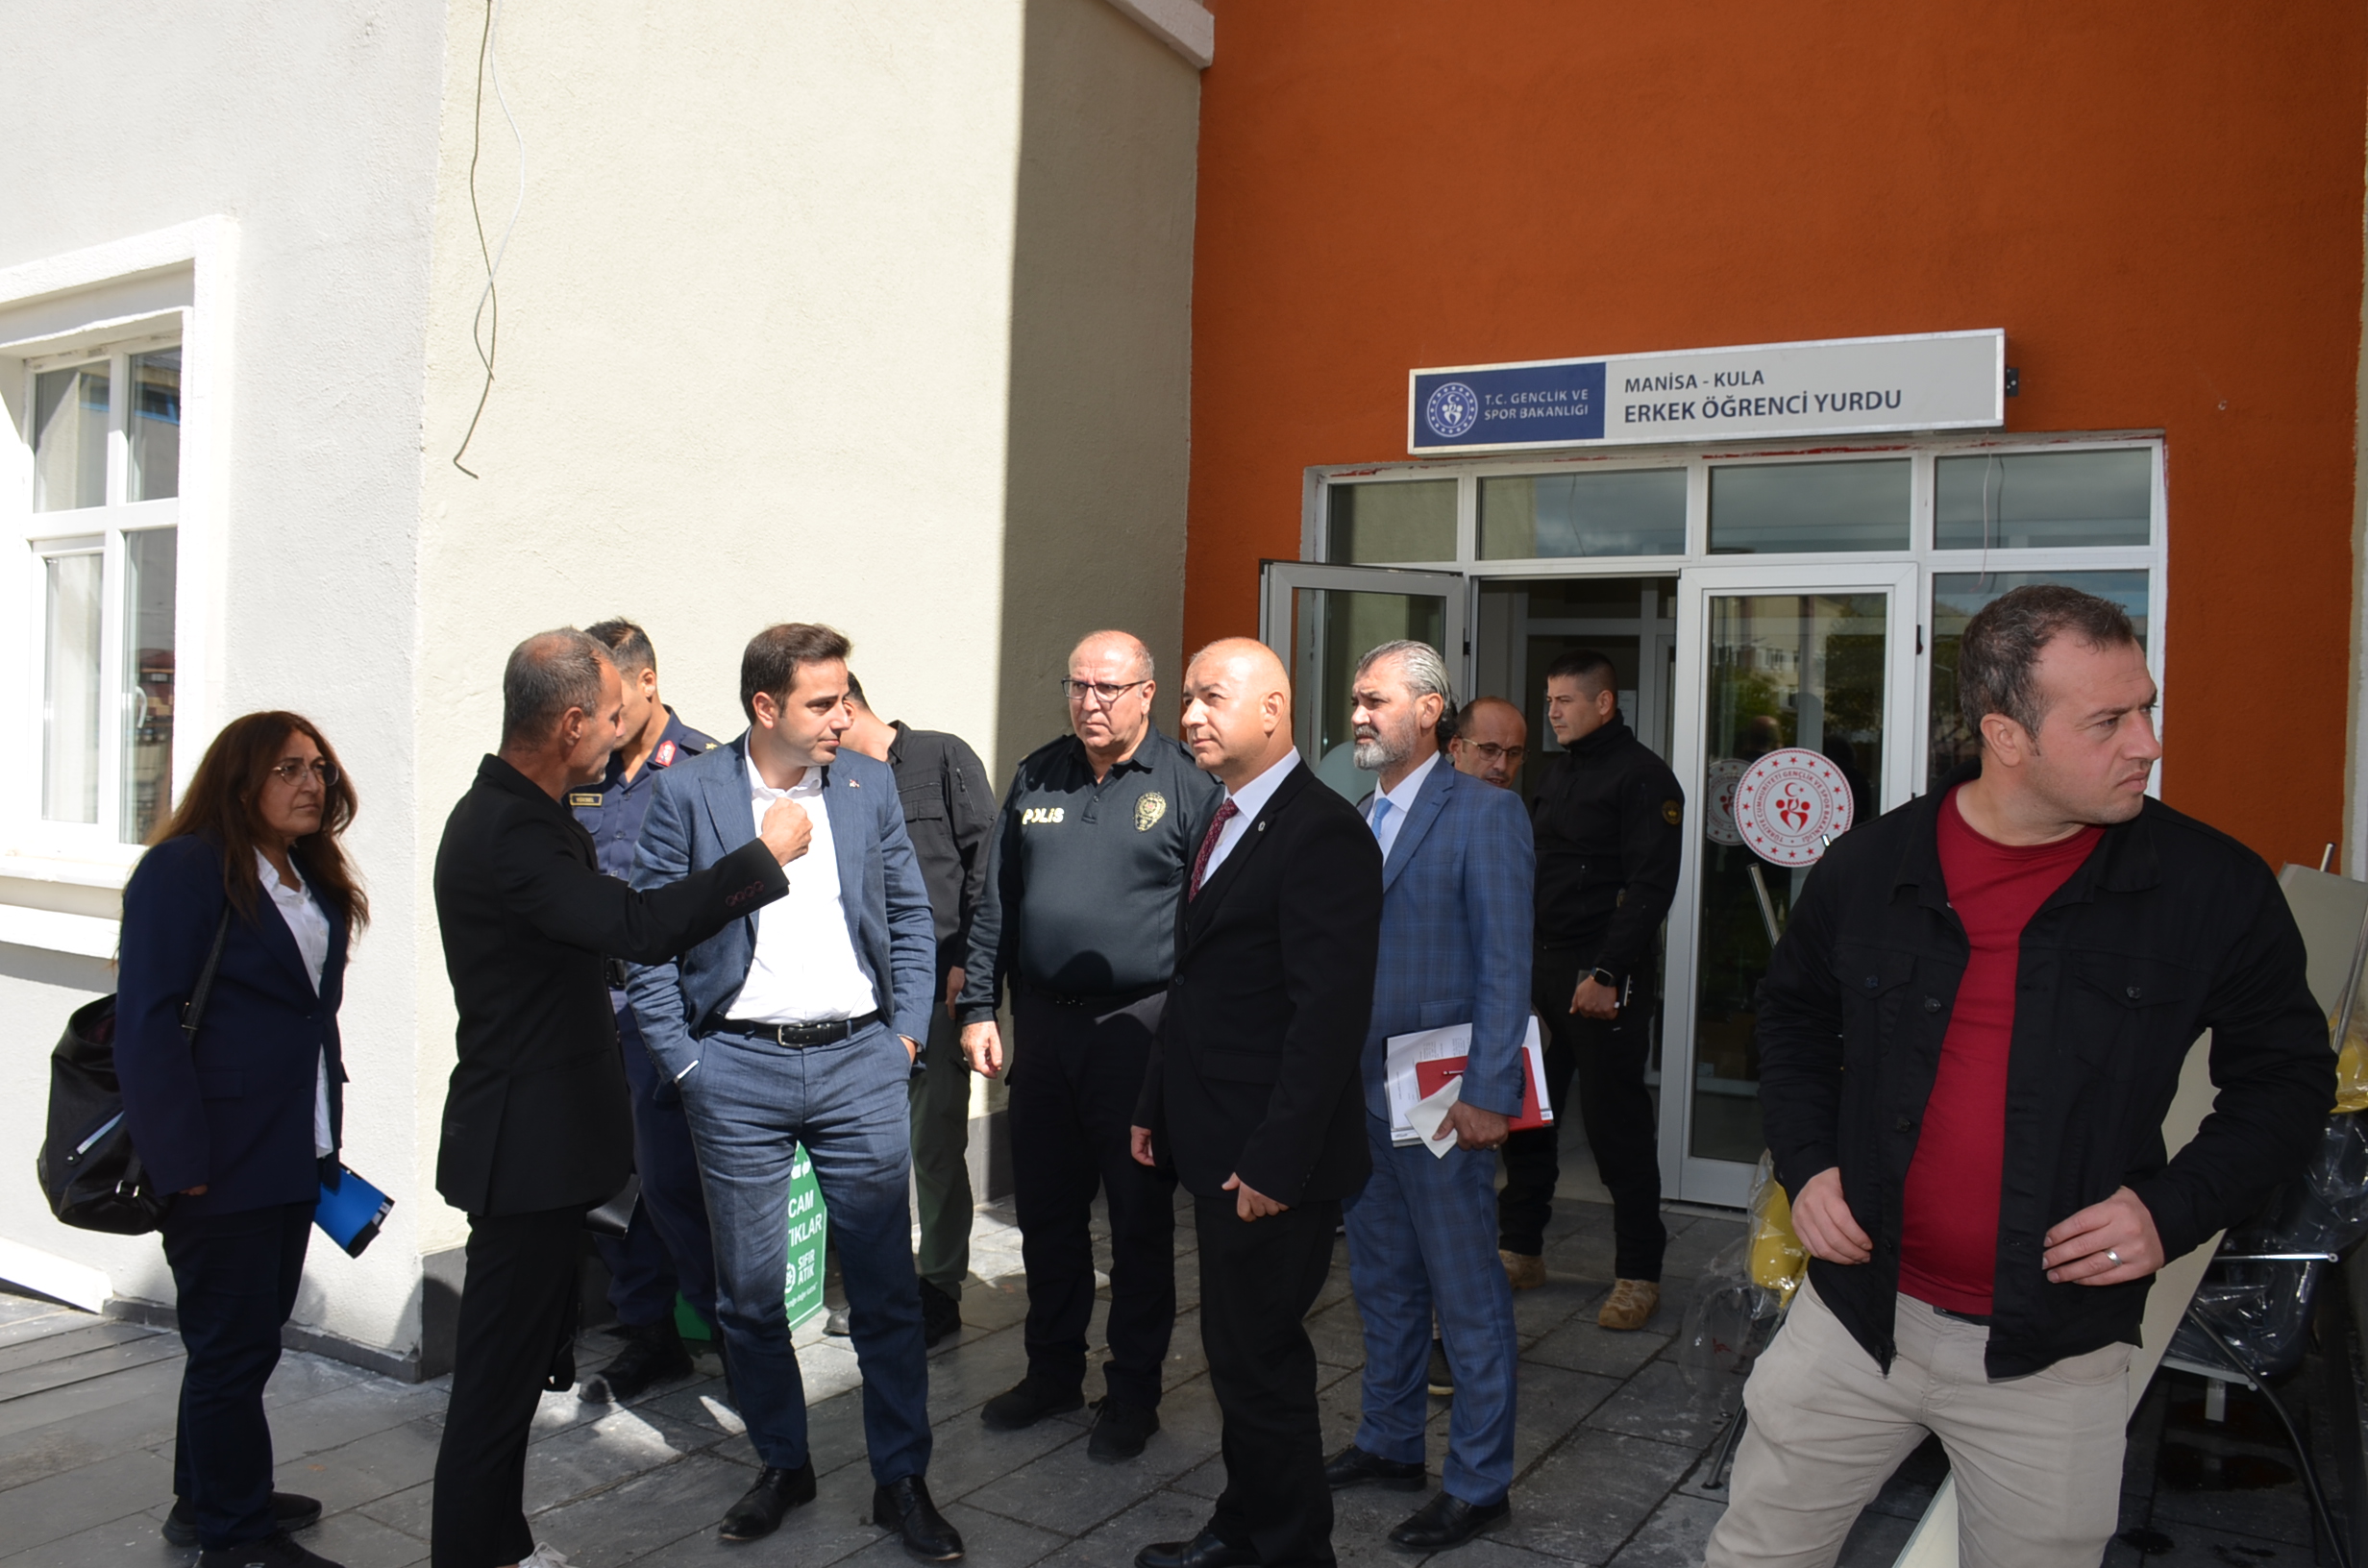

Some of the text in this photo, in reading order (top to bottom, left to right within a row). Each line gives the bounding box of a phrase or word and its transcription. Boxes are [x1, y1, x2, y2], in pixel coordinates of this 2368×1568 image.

[1624, 372, 1698, 393] MANİSA
[1714, 369, 1764, 388] KULA
[1484, 394, 1507, 405] T.C.
[1571, 388, 1589, 401] VE
[1624, 389, 1902, 424] ERKEK ÖĞRENCİ YURDU
[1484, 407, 1517, 421] SPOR
[788, 1188, 814, 1219] CAM
[788, 1213, 823, 1248] IKLAR
[798, 1262, 816, 1286] ATIK
